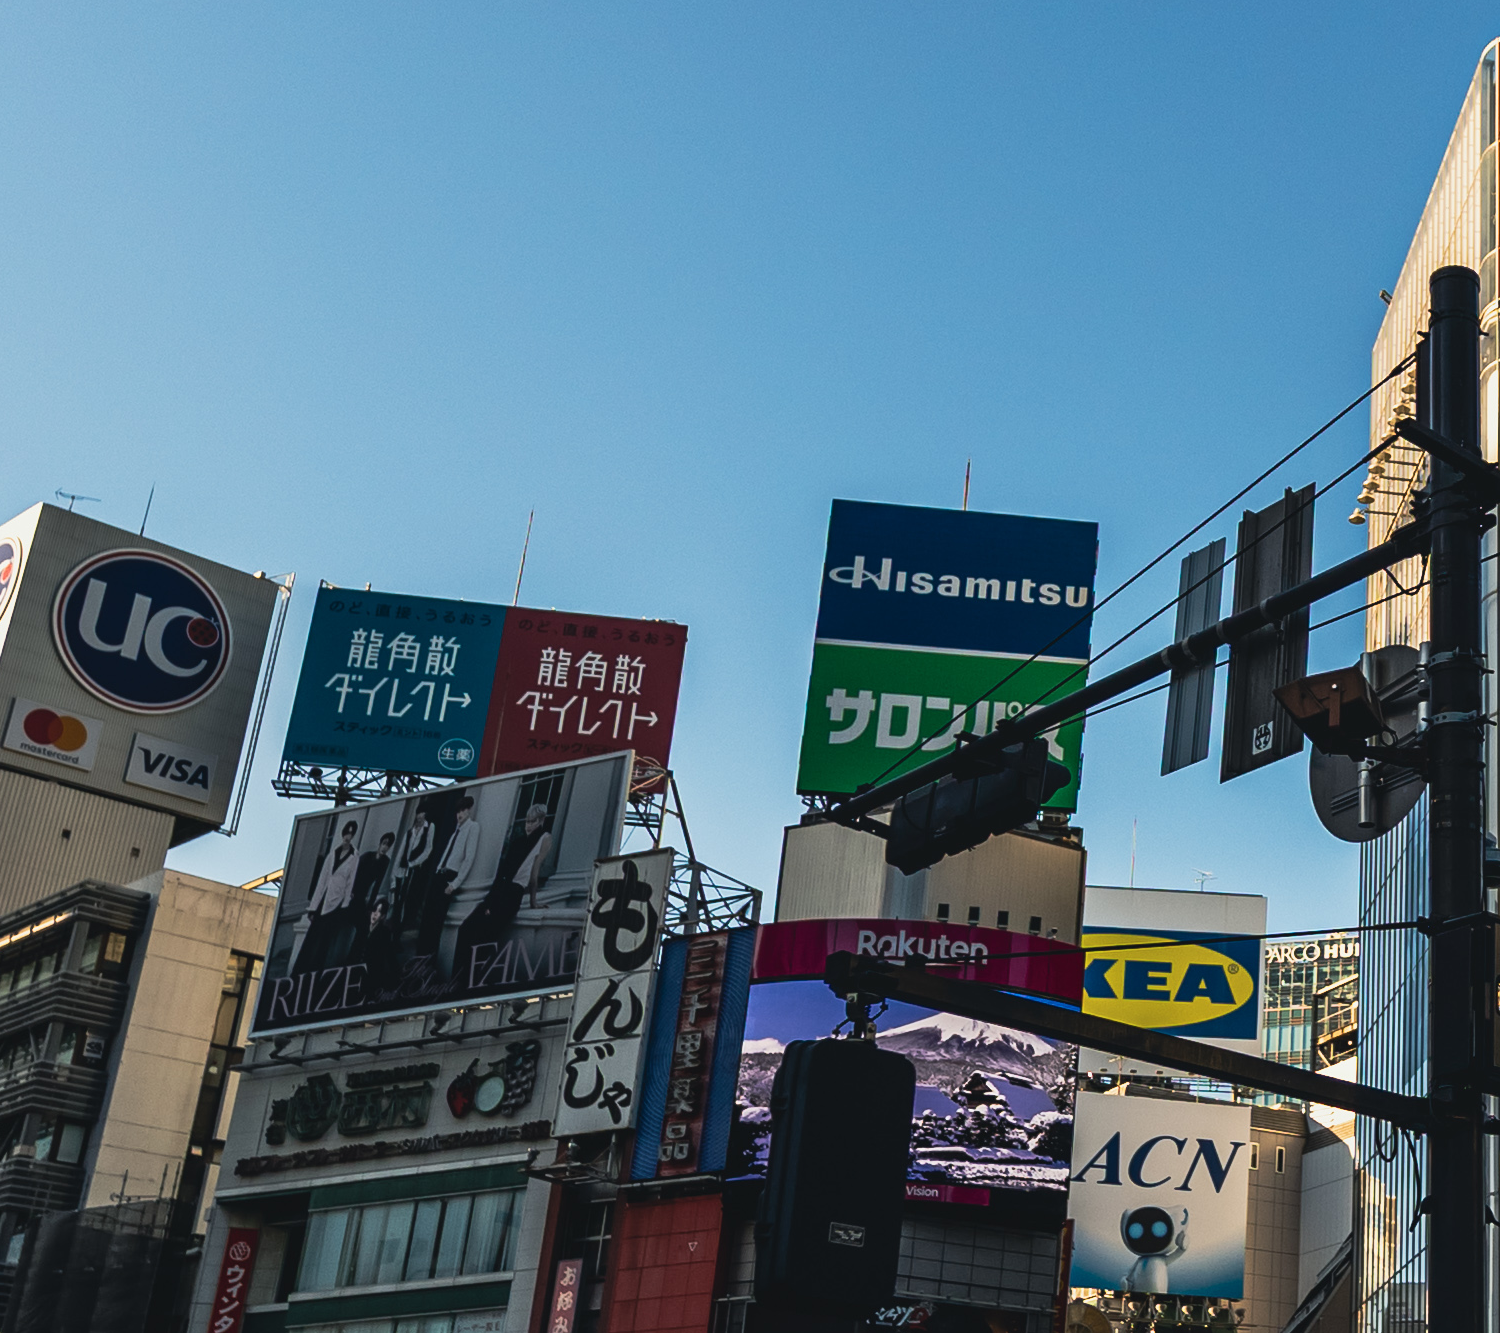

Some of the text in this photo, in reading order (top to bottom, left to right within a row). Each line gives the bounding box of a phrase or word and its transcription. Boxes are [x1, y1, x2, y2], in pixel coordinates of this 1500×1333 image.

[829, 555, 1090, 609] Hisamitsu
[346, 627, 462, 677] 龍角散
[537, 646, 648, 696] 龍角散
[323, 672, 472, 723] ダイレクト
[516, 690, 660, 741] ダイレクト
[19, 741, 80, 766] mastercard
[137, 745, 211, 792] VISA
[857, 929, 989, 965] Rakuten
[266, 961, 369, 1022] RIIZE
[564, 858, 657, 1125] もんじゃ
[1084, 958, 1238, 1005] KEA
[1071, 1131, 1247, 1194] ACN
[905, 1184, 940, 1199] Vision
